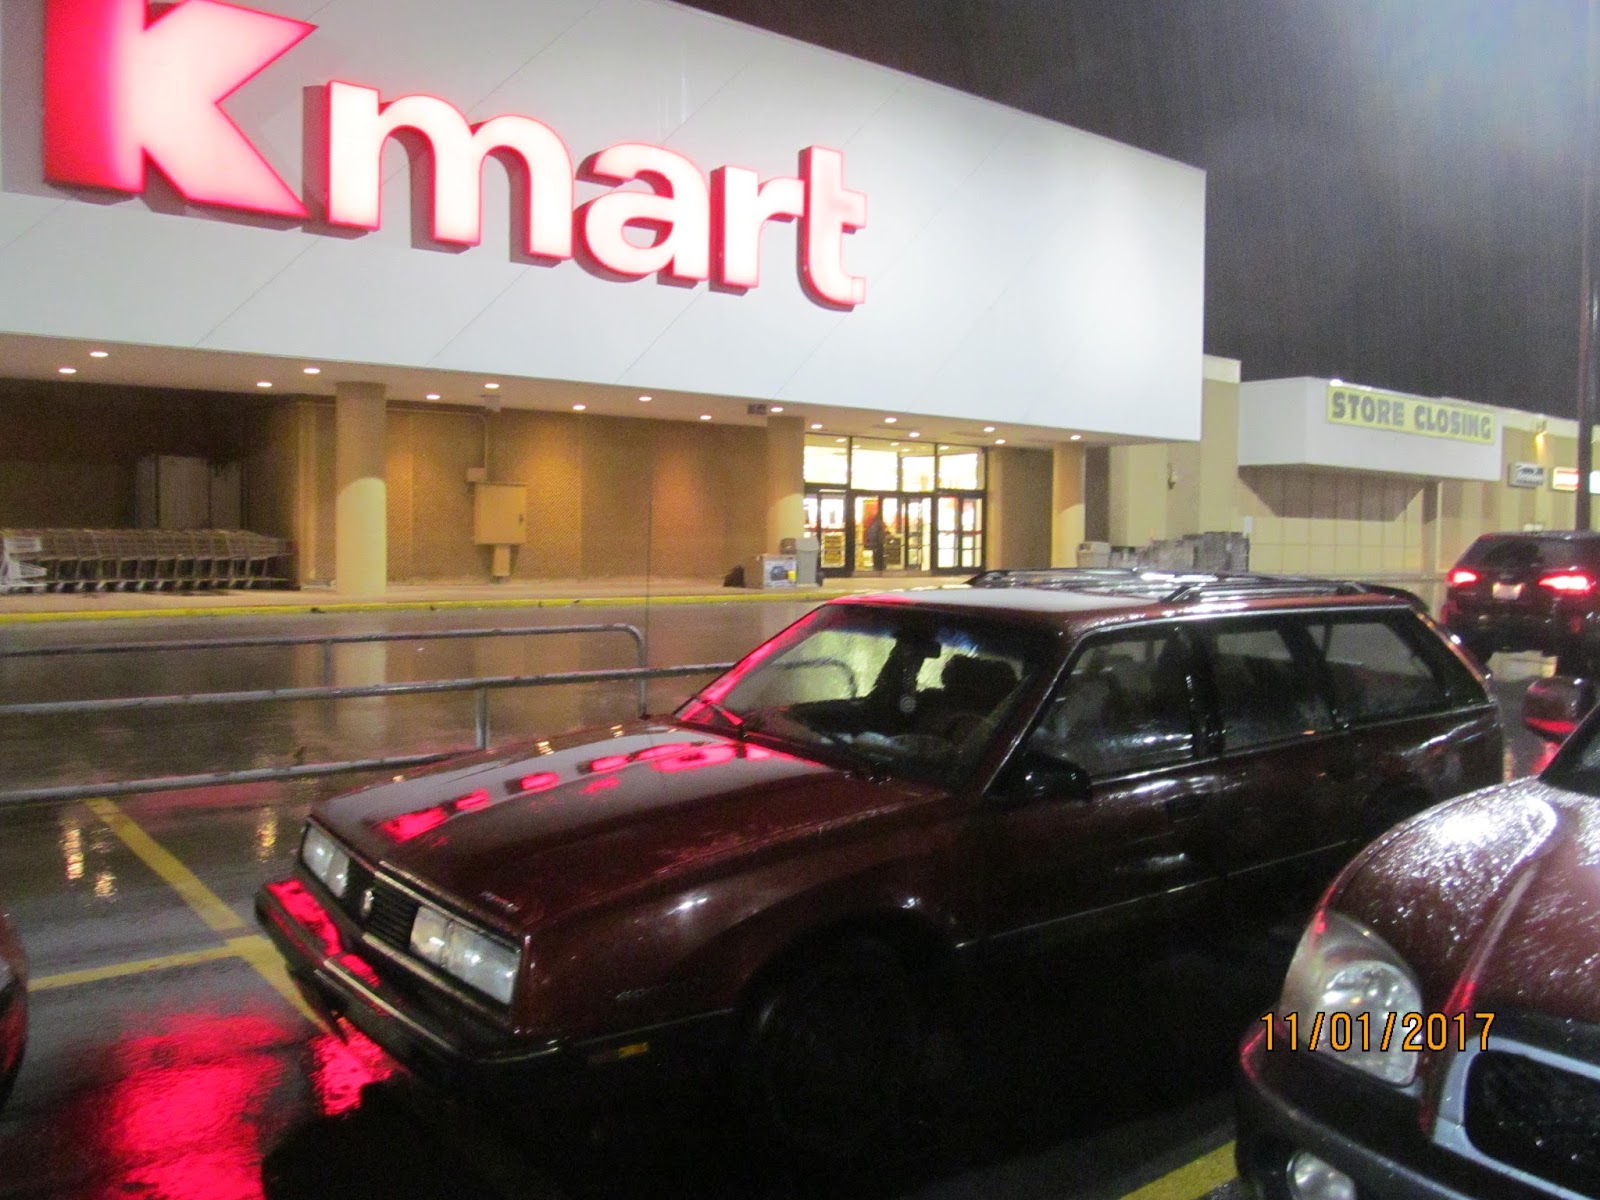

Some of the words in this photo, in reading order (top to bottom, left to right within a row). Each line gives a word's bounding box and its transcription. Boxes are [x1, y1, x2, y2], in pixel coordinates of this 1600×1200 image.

[43, 0, 867, 310] Kmart
[1332, 391, 1405, 426] STORE
[1414, 404, 1491, 440] CLOSING
